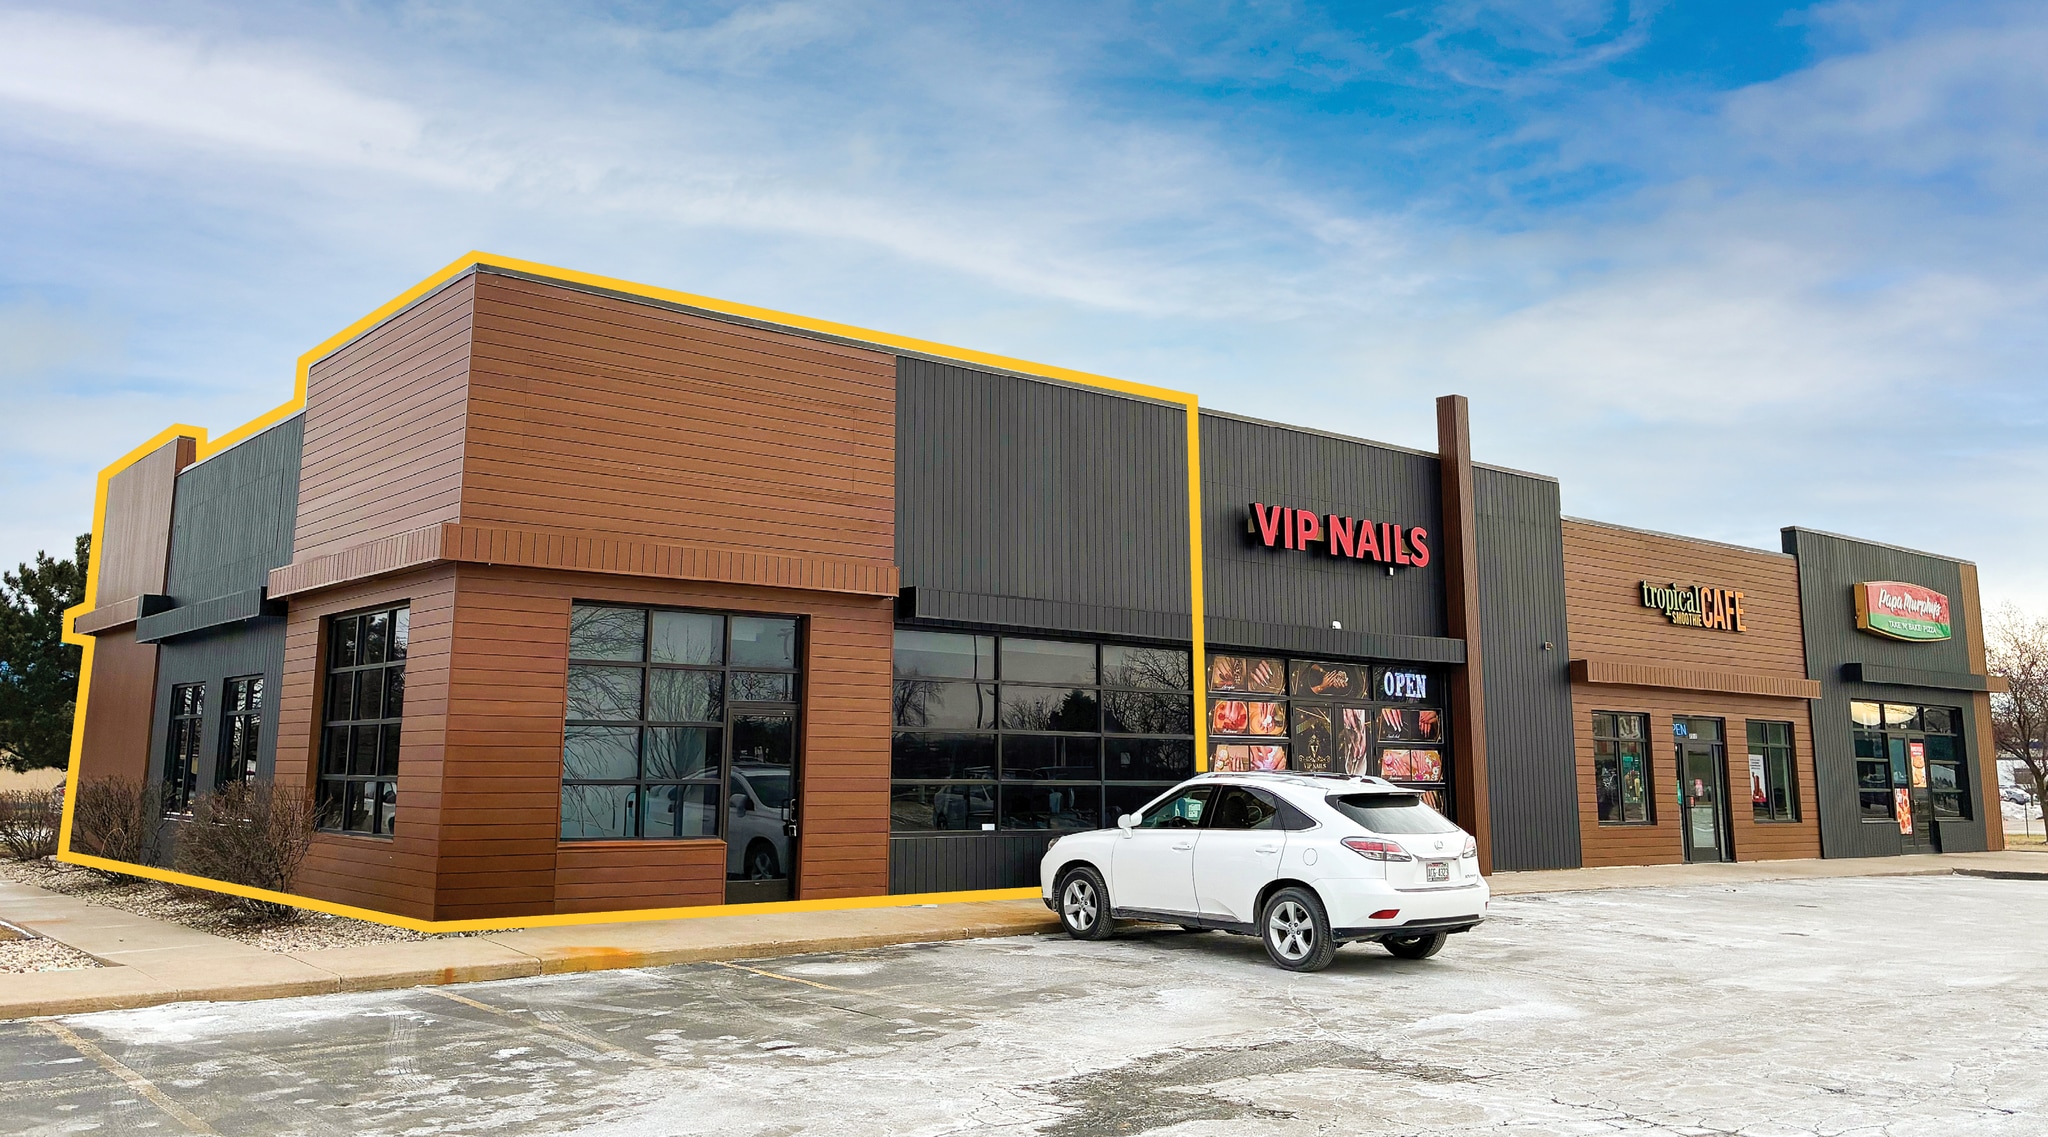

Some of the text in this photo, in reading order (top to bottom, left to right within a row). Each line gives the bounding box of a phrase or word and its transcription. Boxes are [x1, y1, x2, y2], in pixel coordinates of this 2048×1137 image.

[1251, 502, 1430, 568] VIP NAILS
[1642, 579, 1701, 616] tropical
[1701, 586, 1747, 632] CAFE
[1878, 587, 1904, 612] Papa
[1672, 610, 1702, 627] SMOOTHIE
[1888, 620, 1901, 629] TAKE
[1908, 623, 1922, 632] BAKE
[1923, 625, 1937, 634] PIZZA
[1384, 671, 1427, 698] OPEN
[1672, 723, 1688, 736] PEN
